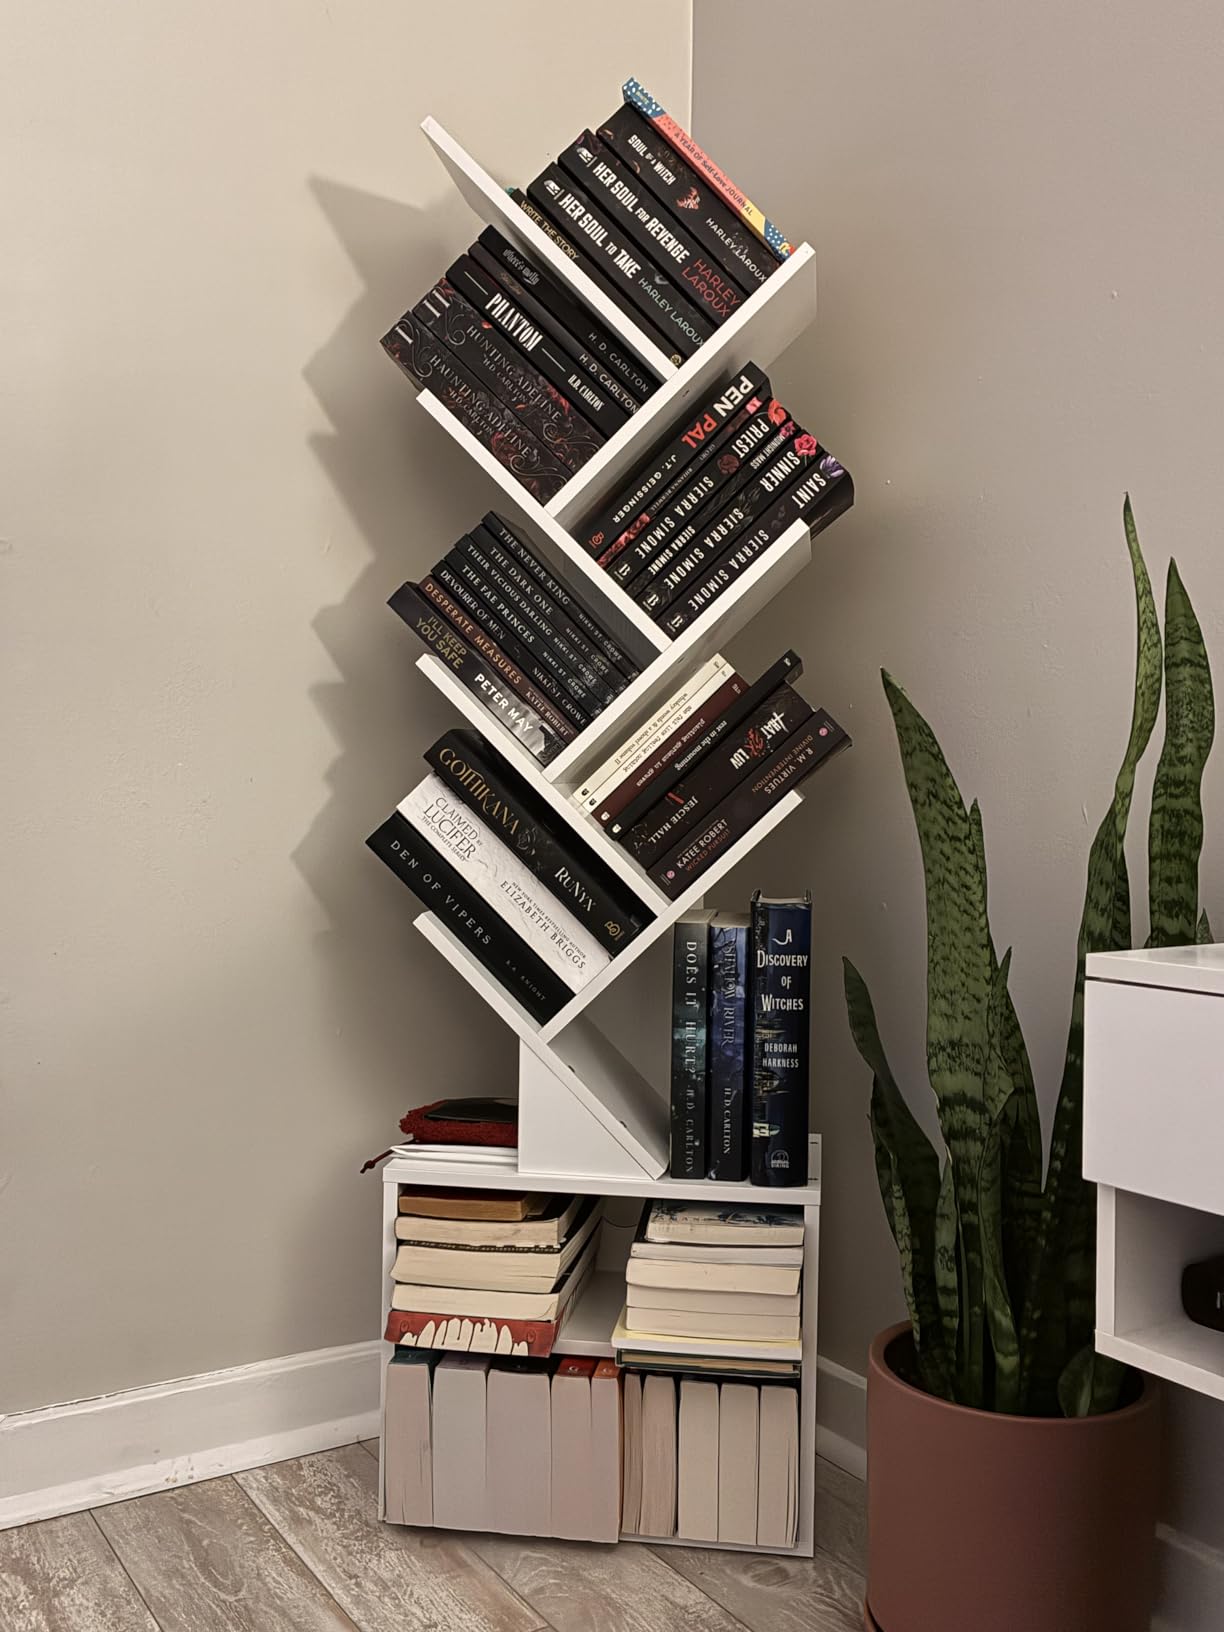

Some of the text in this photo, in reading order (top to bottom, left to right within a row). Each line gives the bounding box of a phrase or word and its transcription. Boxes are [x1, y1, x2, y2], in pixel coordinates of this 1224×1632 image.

[627, 134, 677, 186] SOUL OF A WITCH
[679, 137, 696, 155] YEAR
[693, 151, 703, 161] OF
[725, 186, 753, 216] JOURNAL
[518, 200, 580, 260] WRITE THE STORY
[558, 193, 642, 279] HER SOUL TO TAKE
[592, 162, 691, 264] HER SOUL FOR REVENGE
[705, 217, 768, 283] HARLEY LAROUX
[681, 266, 731, 318] LAROUX
[693, 258, 741, 306] HARLEY
[485, 293, 544, 352] PHANTOM
[638, 277, 706, 349] HARLEY LAROUX
[465, 324, 517, 377] HUNTING
[514, 374, 564, 424] ADELINE
[495, 370, 529, 405] CARLTON
[579, 353, 640, 415] H. D. CARLTON
[588, 332, 649, 393] H. D. CARLTON
[428, 354, 534, 459] HAUNTING ADELINE
[461, 402, 496, 437] CARLTON
[578, 385, 605, 412] CARLTON
[713, 375, 755, 418] PEN
[681, 413, 718, 449] PAL
[731, 418, 771, 459] PRIEST
[750, 432, 786, 470] MIDNIGHT MASS
[612, 454, 677, 524] J.T. GEISSINGER
[759, 451, 801, 493] SINNER
[791, 472, 827, 510] SAINT
[634, 476, 715, 560] SIERRA SIMONE
[499, 527, 571, 605] THE NEVER KING
[647, 525, 696, 576] SIERRA SIMONE
[663, 507, 745, 591] SIERRA SIMONE
[687, 529, 770, 612] SIERRA SIMONE
[440, 569, 506, 640] DEVOURER OF MEN
[462, 564, 536, 644] THE FAE PRINCES
[467, 544, 553, 636] THEIR VICIOUS DARLING
[490, 546, 554, 616] THE DARK ONE
[416, 618, 465, 670] YOU SAFE
[424, 582, 523, 685] DESPERATE MEASURES
[427, 615, 468, 656] I'LL KEEP
[474, 673, 510, 710] PETER
[507, 707, 534, 733] MAY
[532, 667, 552, 689] NIKKI
[561, 698, 587, 725] CROWE
[656, 709, 672, 724] words
[670, 693, 689, 711] whiskey
[544, 711, 569, 737] ROBERT
[634, 729, 650, 746] shovel
[674, 720, 728, 772] rest in the mourning
[680, 718, 706, 743] planting
[619, 743, 637, 760] volume
[636, 767, 655, 787] graves
[728, 746, 751, 771] LUV
[751, 734, 814, 794] DIVINE INTERVENTION
[763, 747, 814, 795] R.M. VIRTUES
[439, 748, 520, 836] GOTHIKANA
[670, 795, 699, 825] JESCIE
[423, 803, 477, 860] LUCIFER
[435, 797, 481, 841] CLAIMED
[647, 822, 673, 844] HALL
[676, 845, 701, 869] KATEE
[698, 818, 728, 848] ROBERT
[685, 849, 709, 872] WICKED
[707, 828, 731, 852] PURSUIT
[390, 840, 492, 945] DEN OF VIPERS
[554, 866, 596, 912] RUNYX
[500, 880, 587, 970] ELIZABETH BRIGGS
[772, 929, 793, 946] A
[684, 941, 697, 1074] DOES IT HURT?
[780, 975, 793, 990] OF
[721, 1007, 736, 1048] RIVER
[764, 1042, 798, 1054] DEBORAH
[762, 1057, 800, 1069] HARKNESS
[685, 1119, 695, 1173] CARLTON
[723, 1110, 732, 1155] CARLTON
